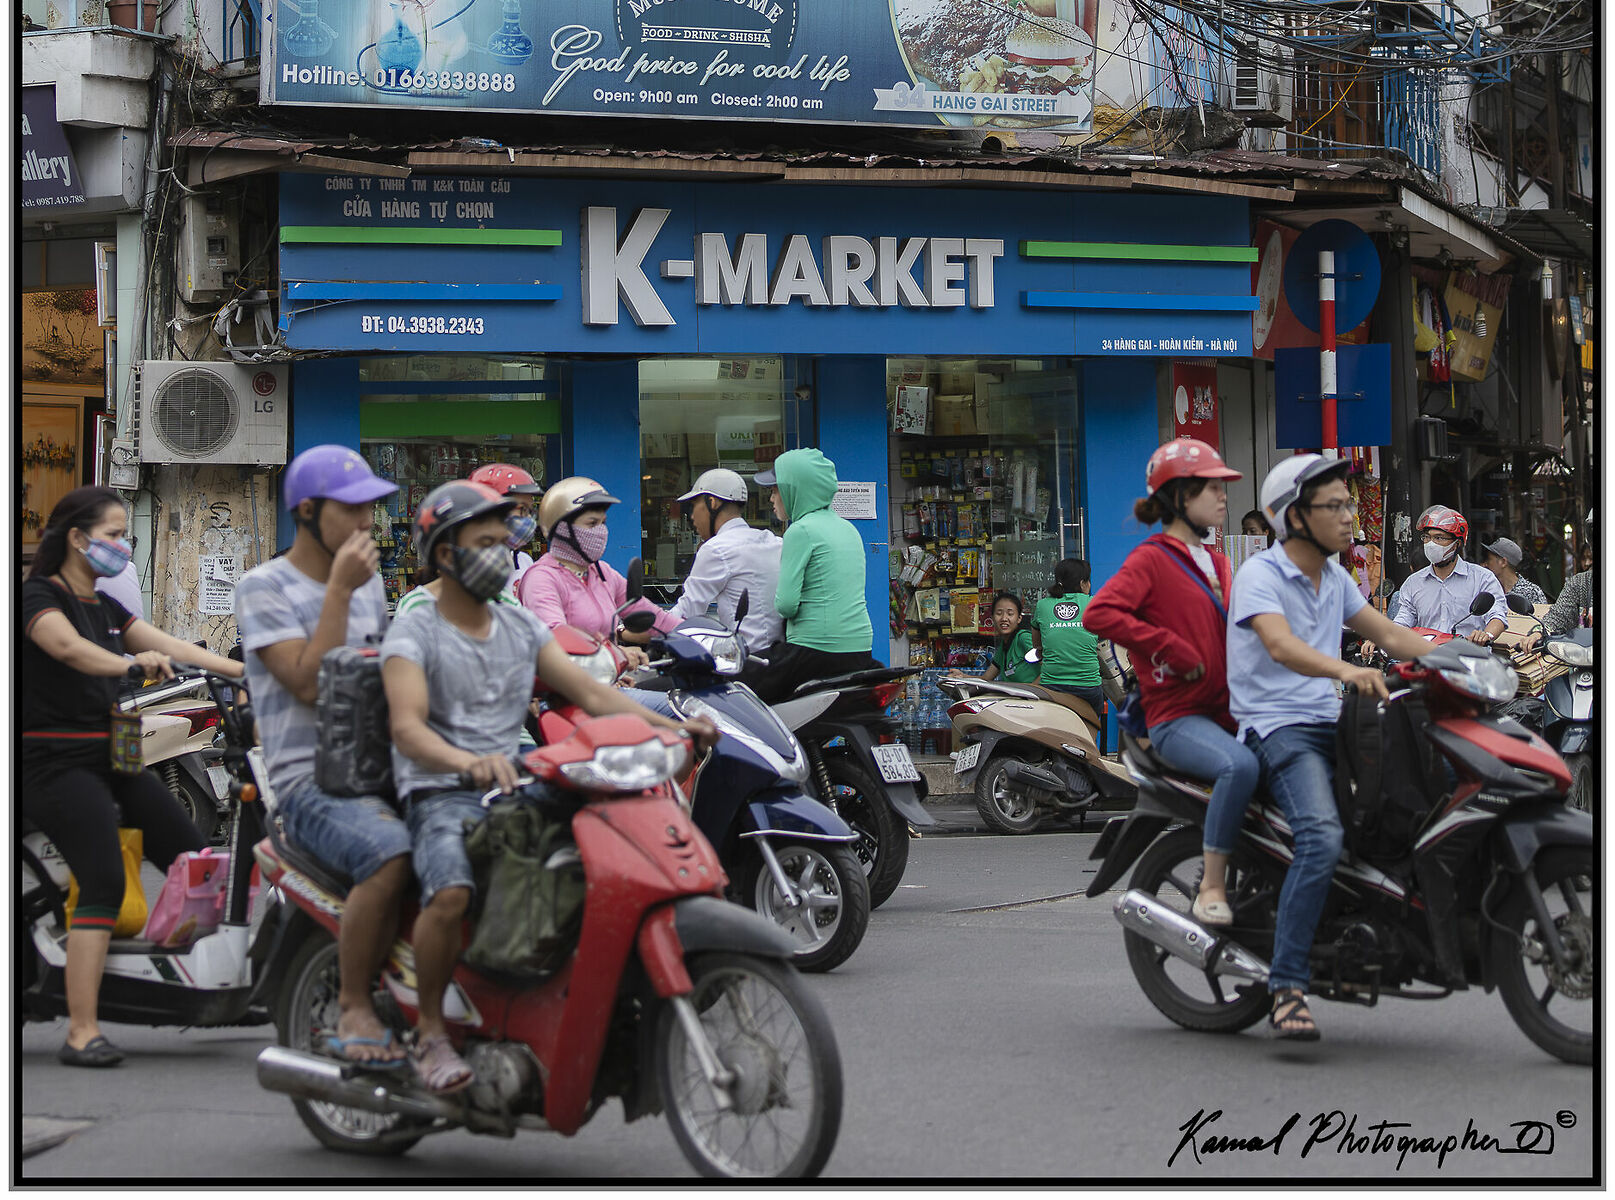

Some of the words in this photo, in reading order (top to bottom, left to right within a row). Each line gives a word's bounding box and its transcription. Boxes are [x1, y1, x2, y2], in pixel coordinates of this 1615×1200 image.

[641, 28, 673, 39] FOOD
[683, 30, 719, 41] DRINK
[728, 33, 770, 44] SHISHA
[541, 24, 632, 106] Good
[623, 52, 699, 83] price
[699, 49, 746, 87] for
[752, 54, 809, 81] cool
[808, 54, 851, 91] life
[281, 63, 368, 88] Hotline:
[373, 69, 516, 94] 01663838888
[592, 87, 635, 104] Open:
[638, 89, 673, 104] 9h00
[676, 93, 699, 104] am
[710, 92, 762, 107] Closed:
[765, 94, 799, 109] 2h00
[802, 98, 824, 110] am
[932, 94, 976, 110] HANG
[981, 97, 1007, 111] GAI
[1012, 98, 1058, 113] STREET
[359, 179, 372, 190] TY
[379, 179, 405, 191] TNHH
[411, 180, 427, 192] TM
[381, 198, 420, 218] HÀNG
[580, 205, 1005, 327] K-MARKET
[387, 316, 484, 335] 04.3938.2343
[1101, 339, 1113, 350] 34
[1114, 338, 1137, 351] HÀNG
[1138, 340, 1152, 351] GAI
[1159, 338, 1181, 351] HOÀN
[1210, 337, 1222, 351] HÀ
[254, 400, 274, 413] LG
